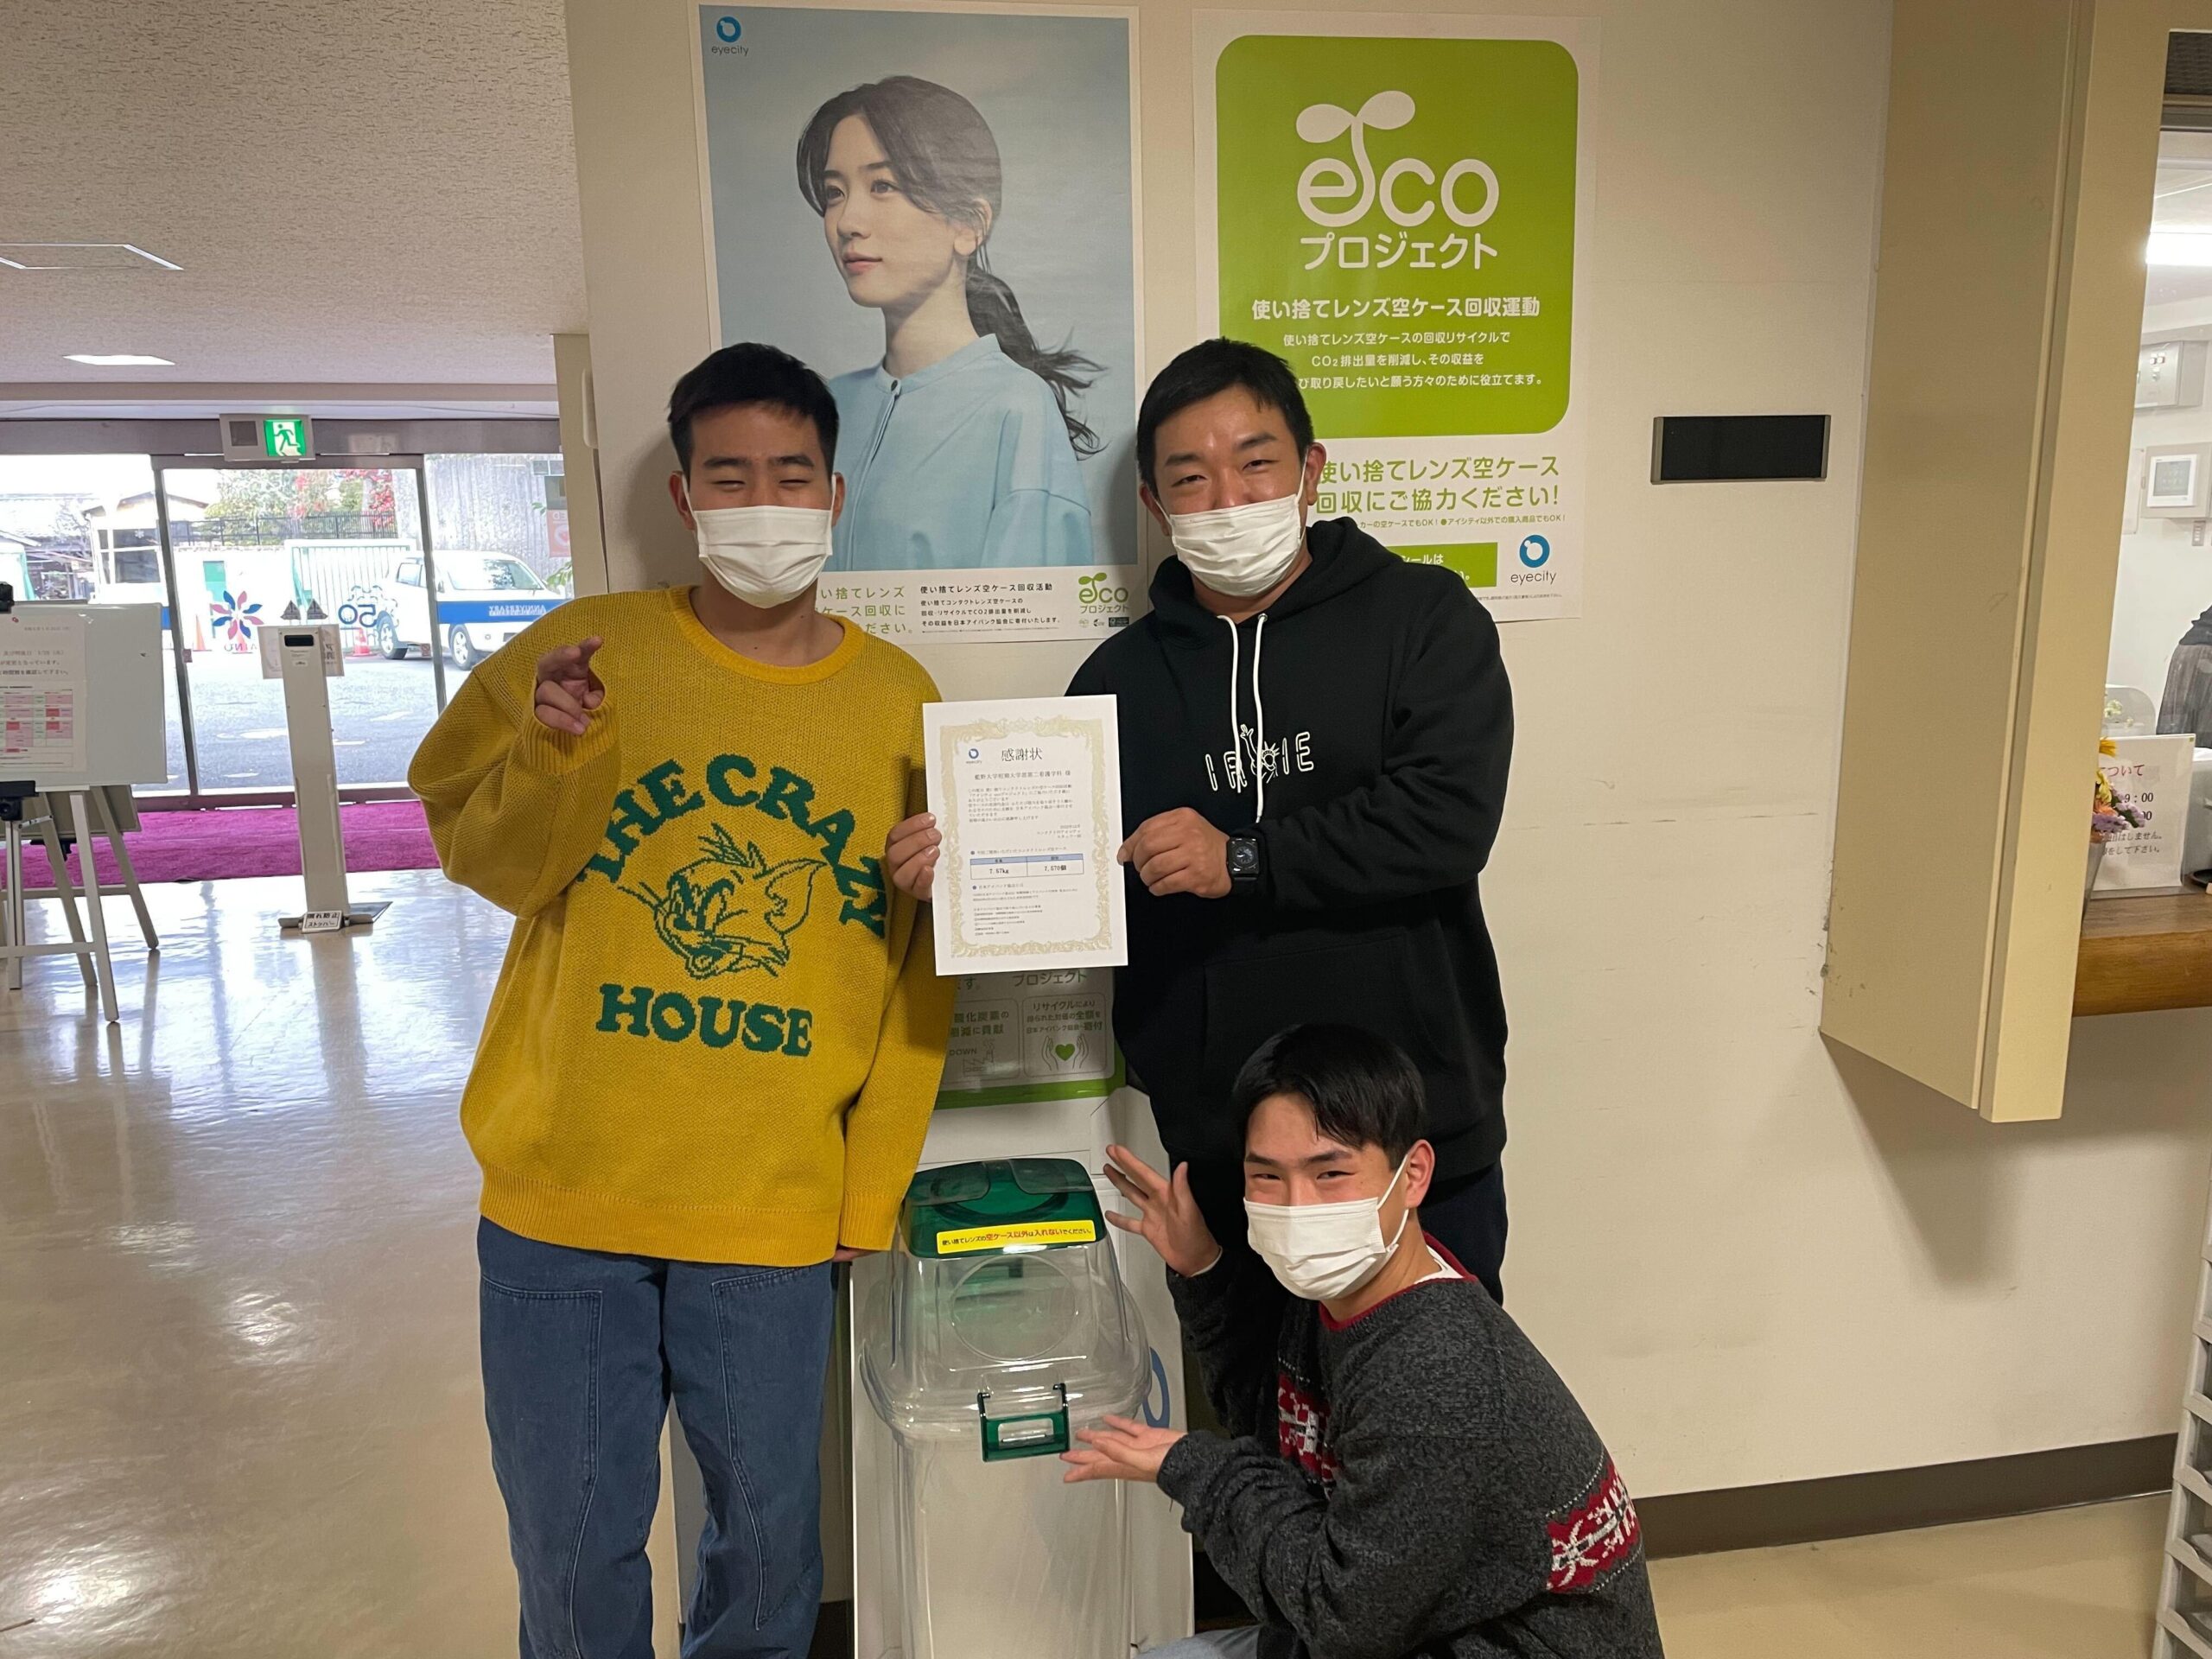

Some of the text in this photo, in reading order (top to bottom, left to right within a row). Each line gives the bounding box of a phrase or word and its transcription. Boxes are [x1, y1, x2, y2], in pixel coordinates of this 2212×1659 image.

[711, 45, 749, 57] eyecity
[1296, 112, 1499, 227] eco
[1300, 232, 1498, 270] プロジェクト
[1252, 296, 1541, 321] 使い捨てレンズ空ケース回収運動
[1283, 331, 1511, 346] 使い捨てレンズ空ケースの回収リサイクルで
[920, 583, 1053, 594] 使い捨てレンズ空ケース回収活動
[1510, 571, 1557, 587] eyecity
[1078, 581, 1128, 604] eco
[1080, 605, 1130, 614] プロジェクト
[1001, 747, 1043, 762] 感謝状
[706, 753, 887, 939] CRAZY
[1013, 969, 1088, 988] プロジェクト
[596, 982, 813, 1058] HOUSE
